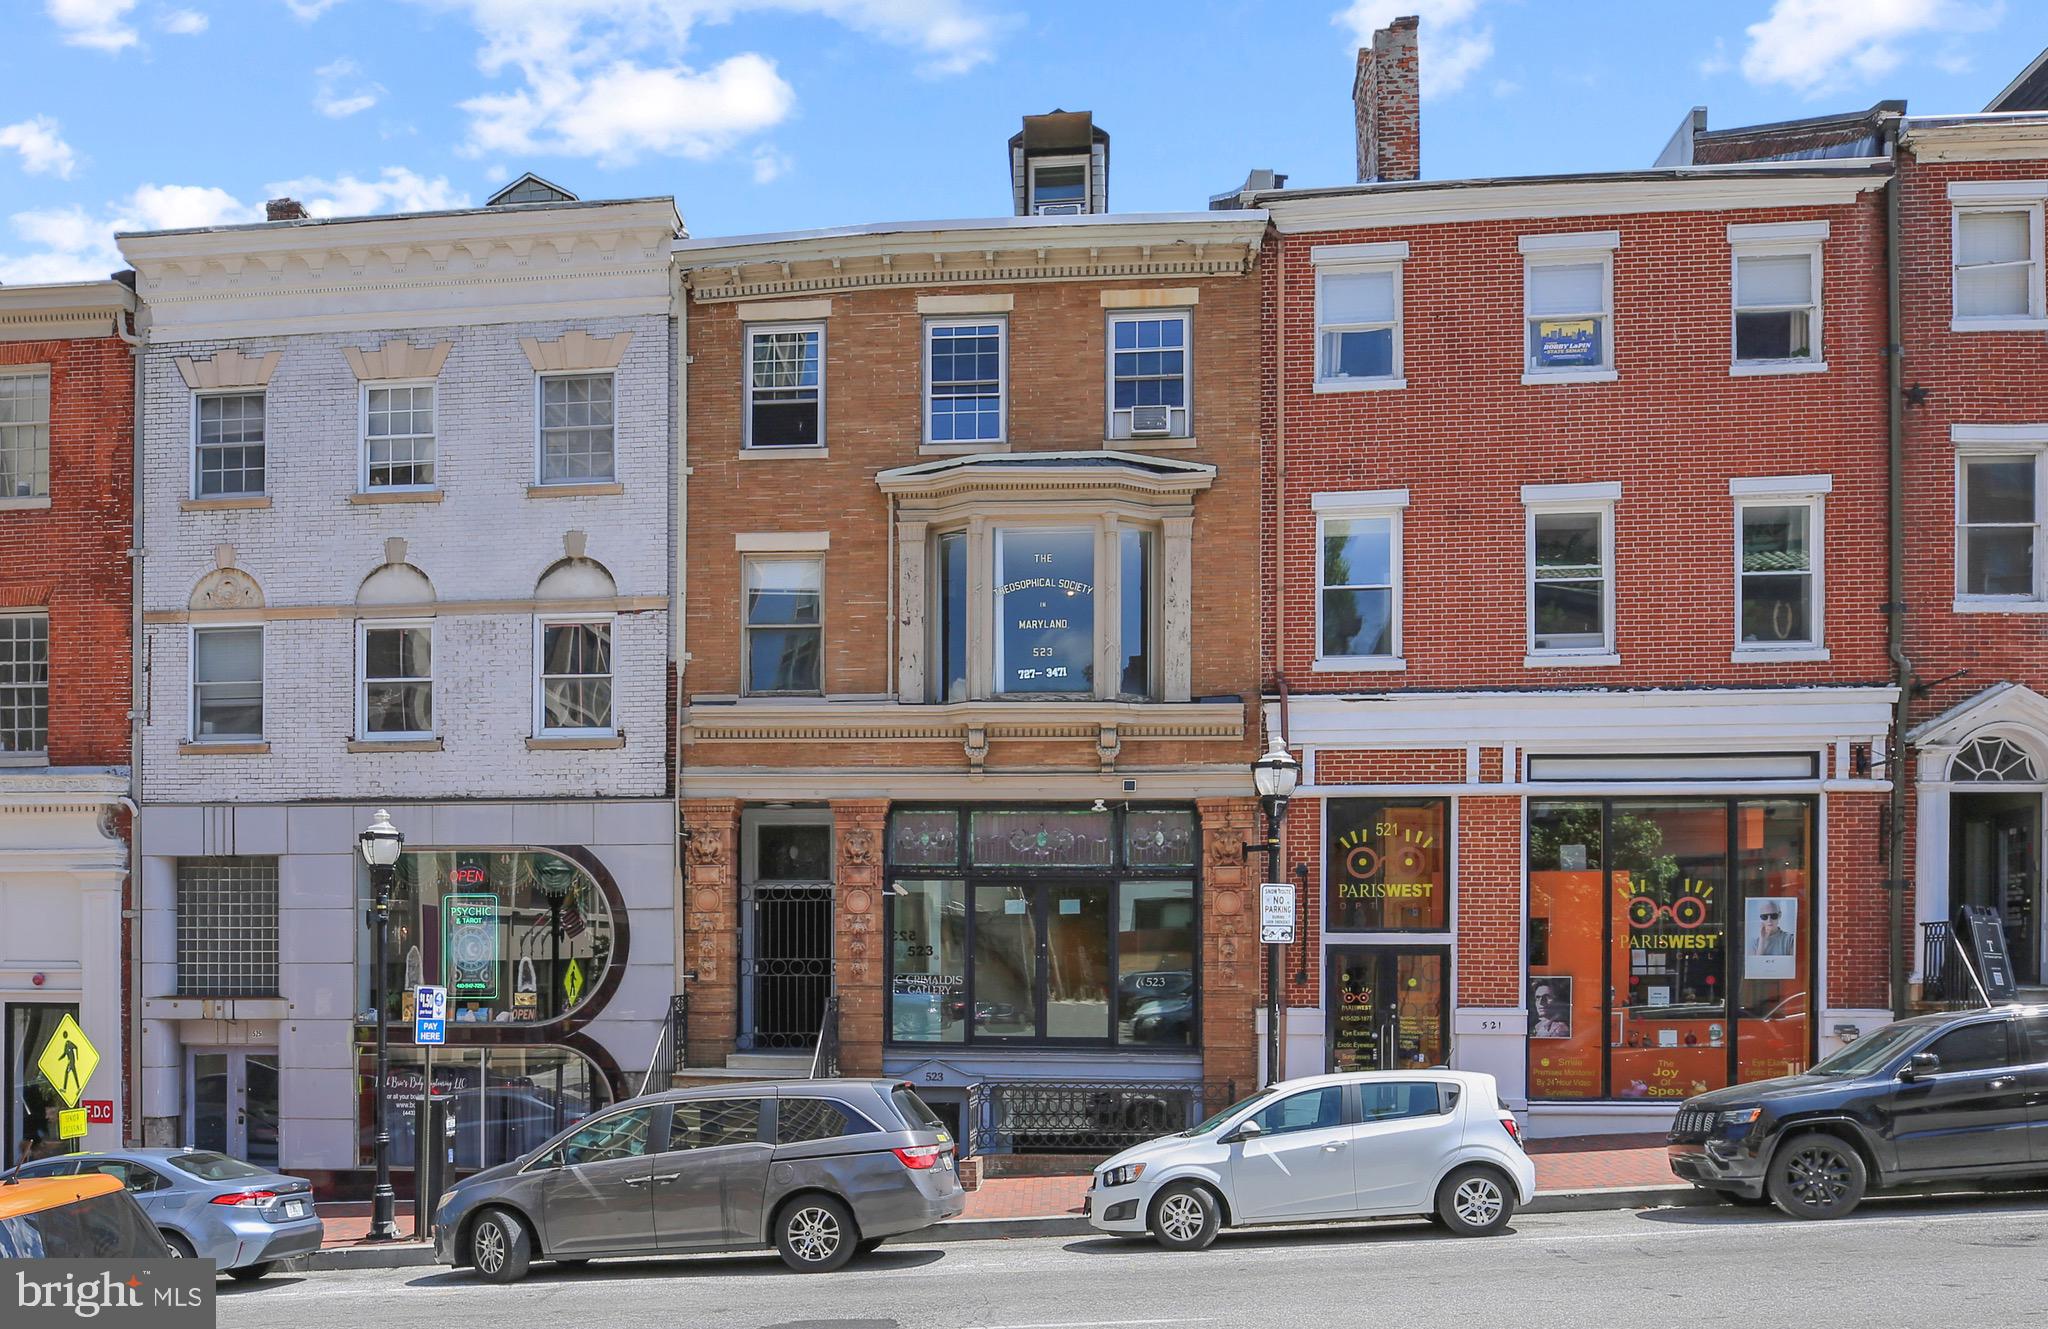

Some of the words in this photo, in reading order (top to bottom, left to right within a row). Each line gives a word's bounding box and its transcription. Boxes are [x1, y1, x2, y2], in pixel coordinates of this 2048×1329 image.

[1034, 554, 1052, 563] THE
[993, 578, 1055, 597] THEOSOPHICAL
[1058, 578, 1093, 595] SOCIETY
[1018, 619, 1068, 629] MARYLAND
[1033, 648, 1053, 657] 523
[1375, 822, 1398, 836] 521
[450, 870, 484, 882] OPEN
[1338, 883, 1433, 898] PARISWEST
[1273, 896, 1285, 904] NO
[450, 907, 492, 917] PSYCHIC
[1264, 905, 1291, 913] PARKING
[456, 917, 461, 925] &
[1620, 934, 1717, 949] PARISWEST
[1986, 940, 1994, 952] T
[908, 945, 933, 957] 523
[905, 975, 963, 985] GRIMALDIS
[1145, 977, 1166, 987] 523
[907, 985, 951, 995] GALLERY
[512, 1009, 535, 1020] OPEN
[423, 1022, 438, 1030] PAY
[1481, 1021, 1501, 1030] 521
[420, 1032, 440, 1040] HERE
[926, 1072, 944, 1081] 523
[1653, 1067, 1679, 1079] Joy
[1648, 1086, 1684, 1096] Spex
